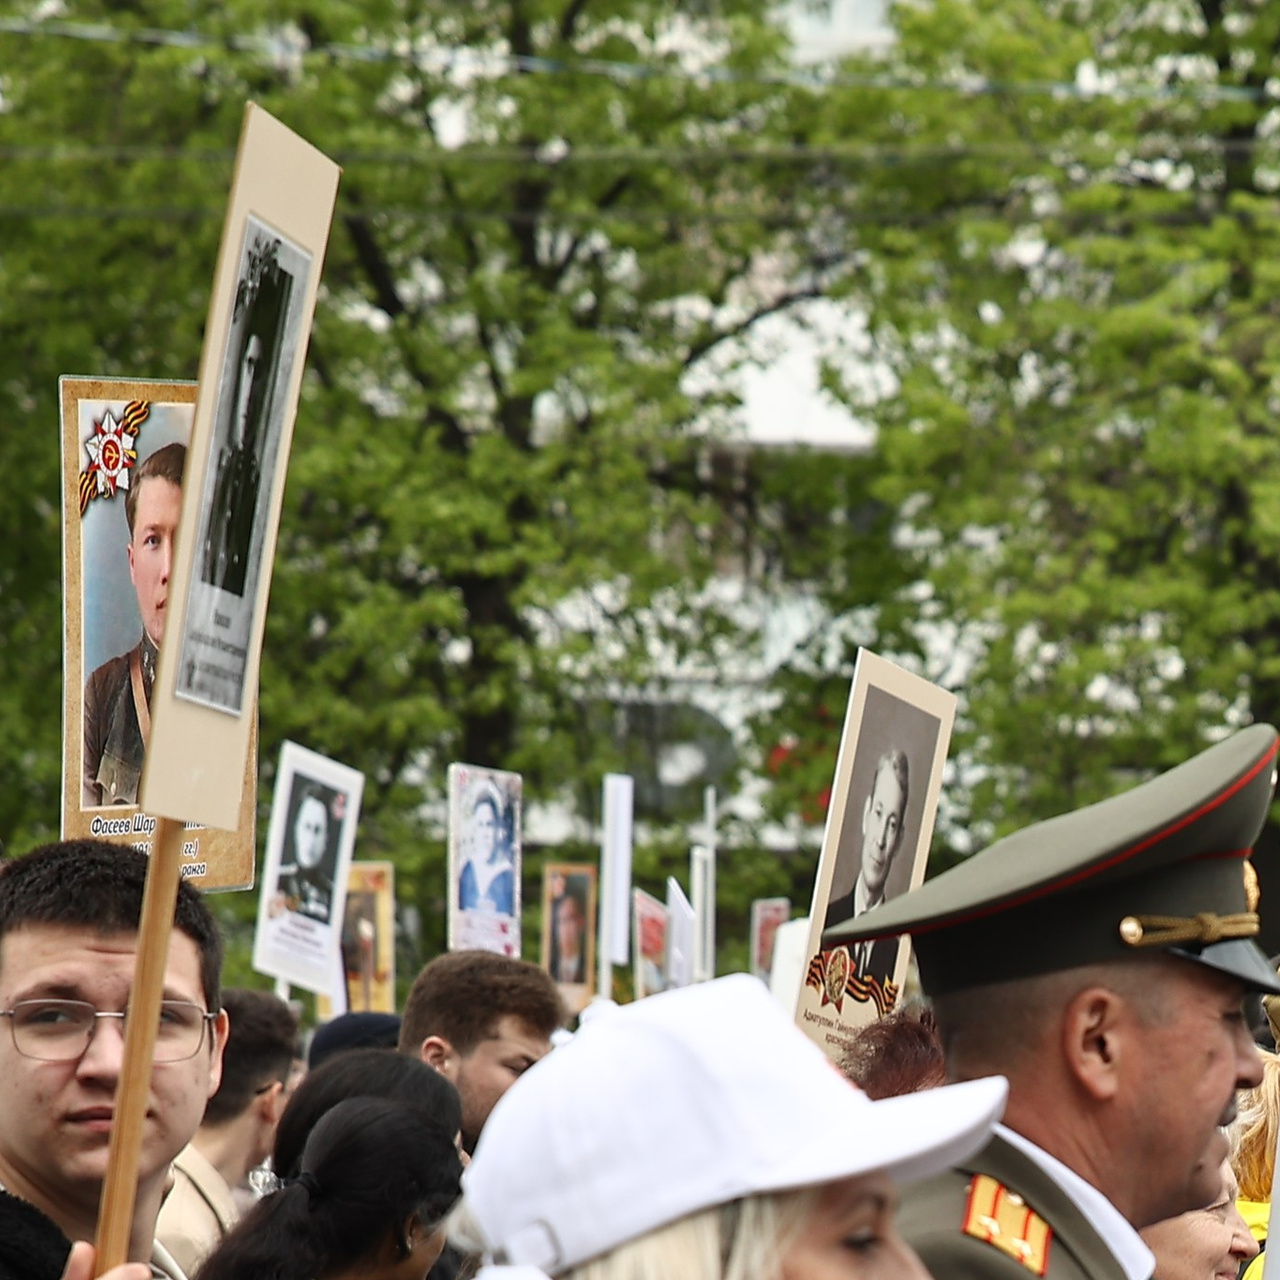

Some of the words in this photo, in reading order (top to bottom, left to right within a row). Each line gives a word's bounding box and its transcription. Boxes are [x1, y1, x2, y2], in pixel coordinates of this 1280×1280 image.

[91, 818, 130, 834] Фасеев
[132, 815, 155, 834] Шар
[181, 863, 206, 876] ранга
